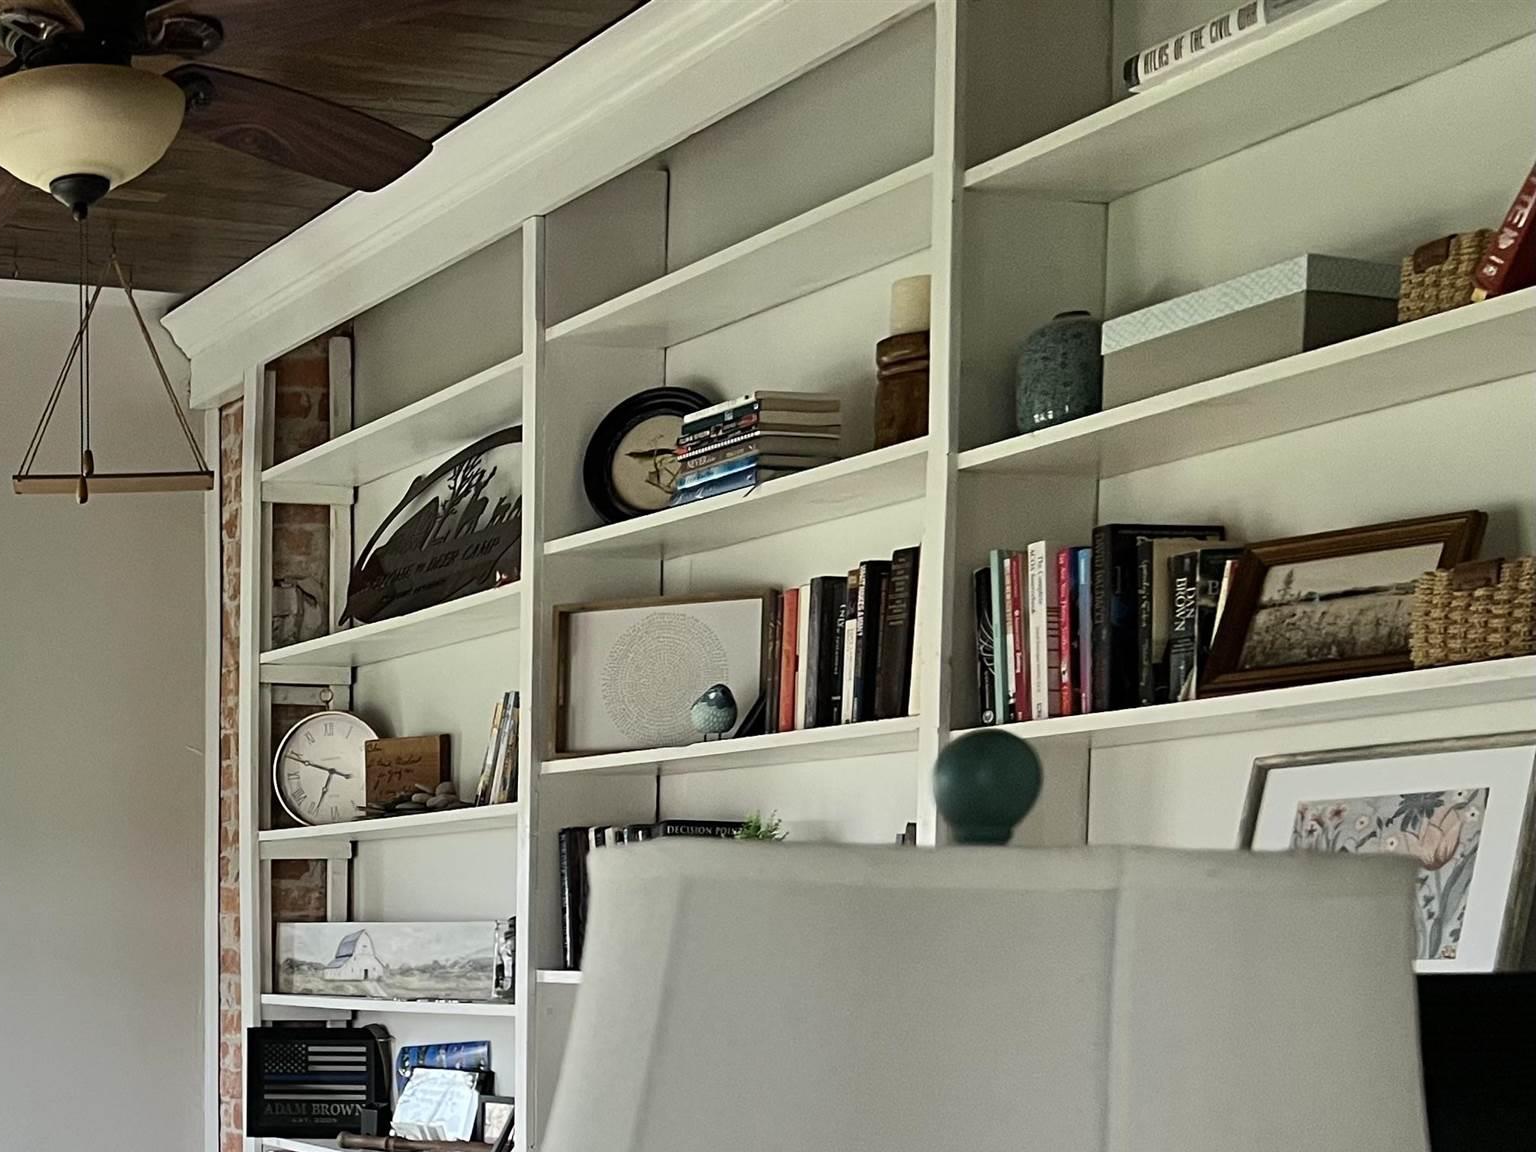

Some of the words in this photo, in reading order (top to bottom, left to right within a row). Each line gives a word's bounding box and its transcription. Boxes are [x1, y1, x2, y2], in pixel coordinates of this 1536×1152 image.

[1144, 42, 1169, 75] ATLAS
[1174, 36, 1184, 60] OF
[1190, 25, 1205, 53] THE
[1209, 15, 1232, 43] CIVIL
[426, 550, 459, 572] DEER
[463, 538, 500, 560] CAMP
[1094, 569, 1106, 624] BALDACCI
[1173, 577, 1187, 632] BROWN
[1184, 586, 1196, 619] DAN
[666, 825, 712, 834] DECISION
[264, 1103, 308, 1116] ADAM
[311, 1103, 366, 1116] BROWN
